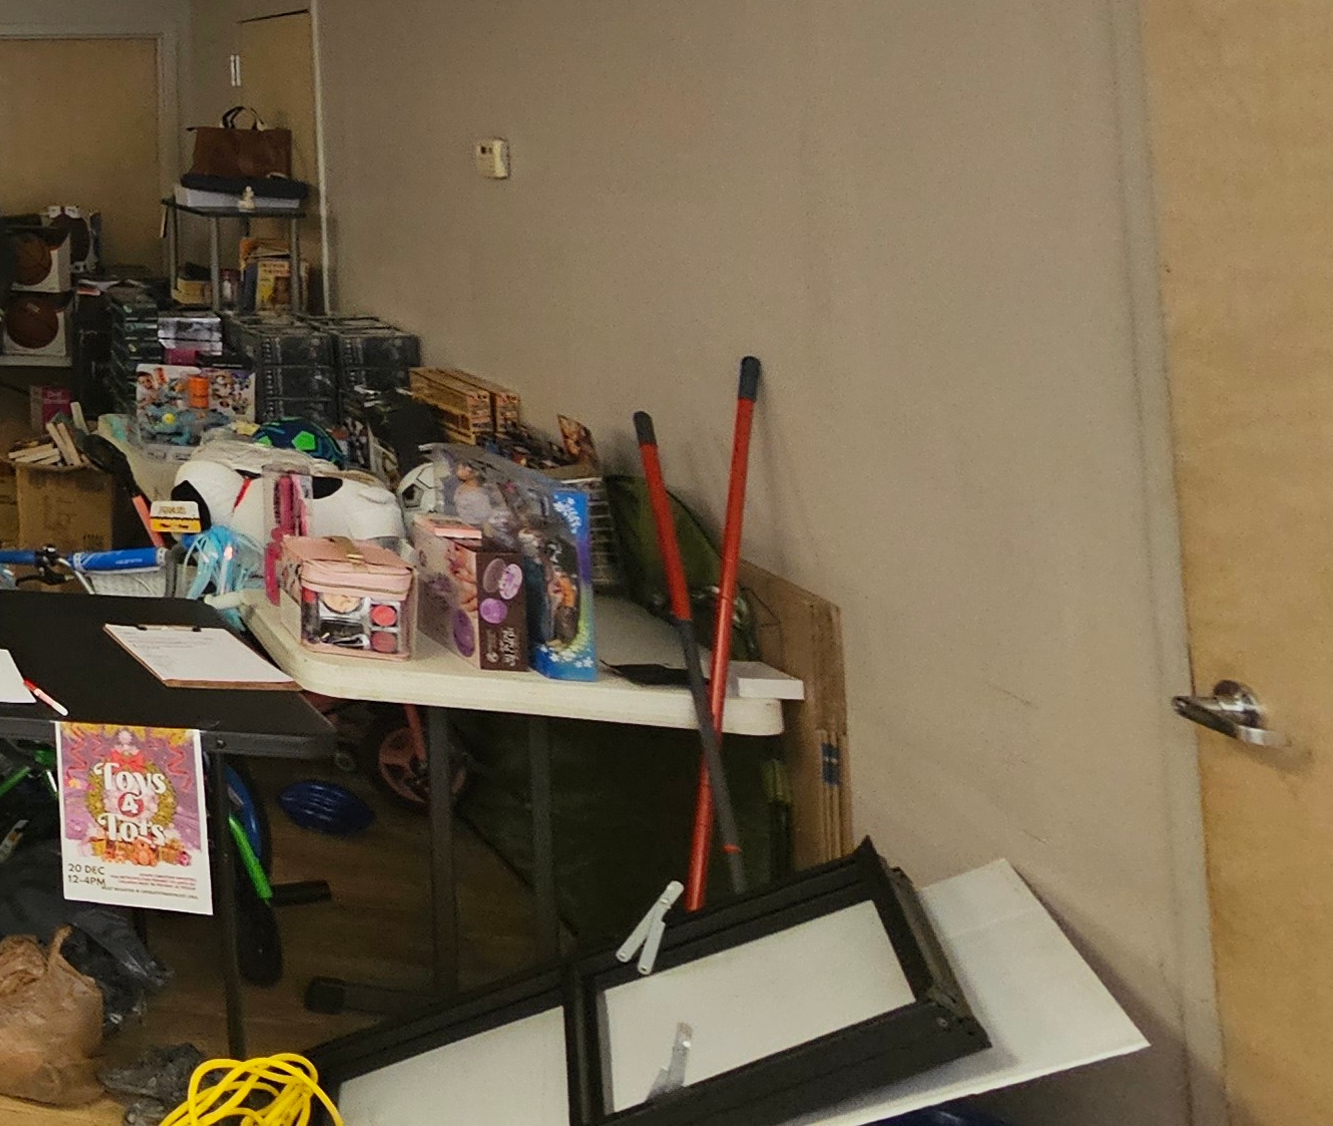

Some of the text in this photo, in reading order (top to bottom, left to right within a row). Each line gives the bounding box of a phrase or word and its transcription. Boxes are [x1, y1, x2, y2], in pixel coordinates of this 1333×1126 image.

[93, 762, 167, 799] Toys
[122, 793, 139, 814] 4
[97, 812, 166, 846] Tots
[68, 863, 105, 875] 20 DEC
[68, 874, 106, 886] 12-4PM
